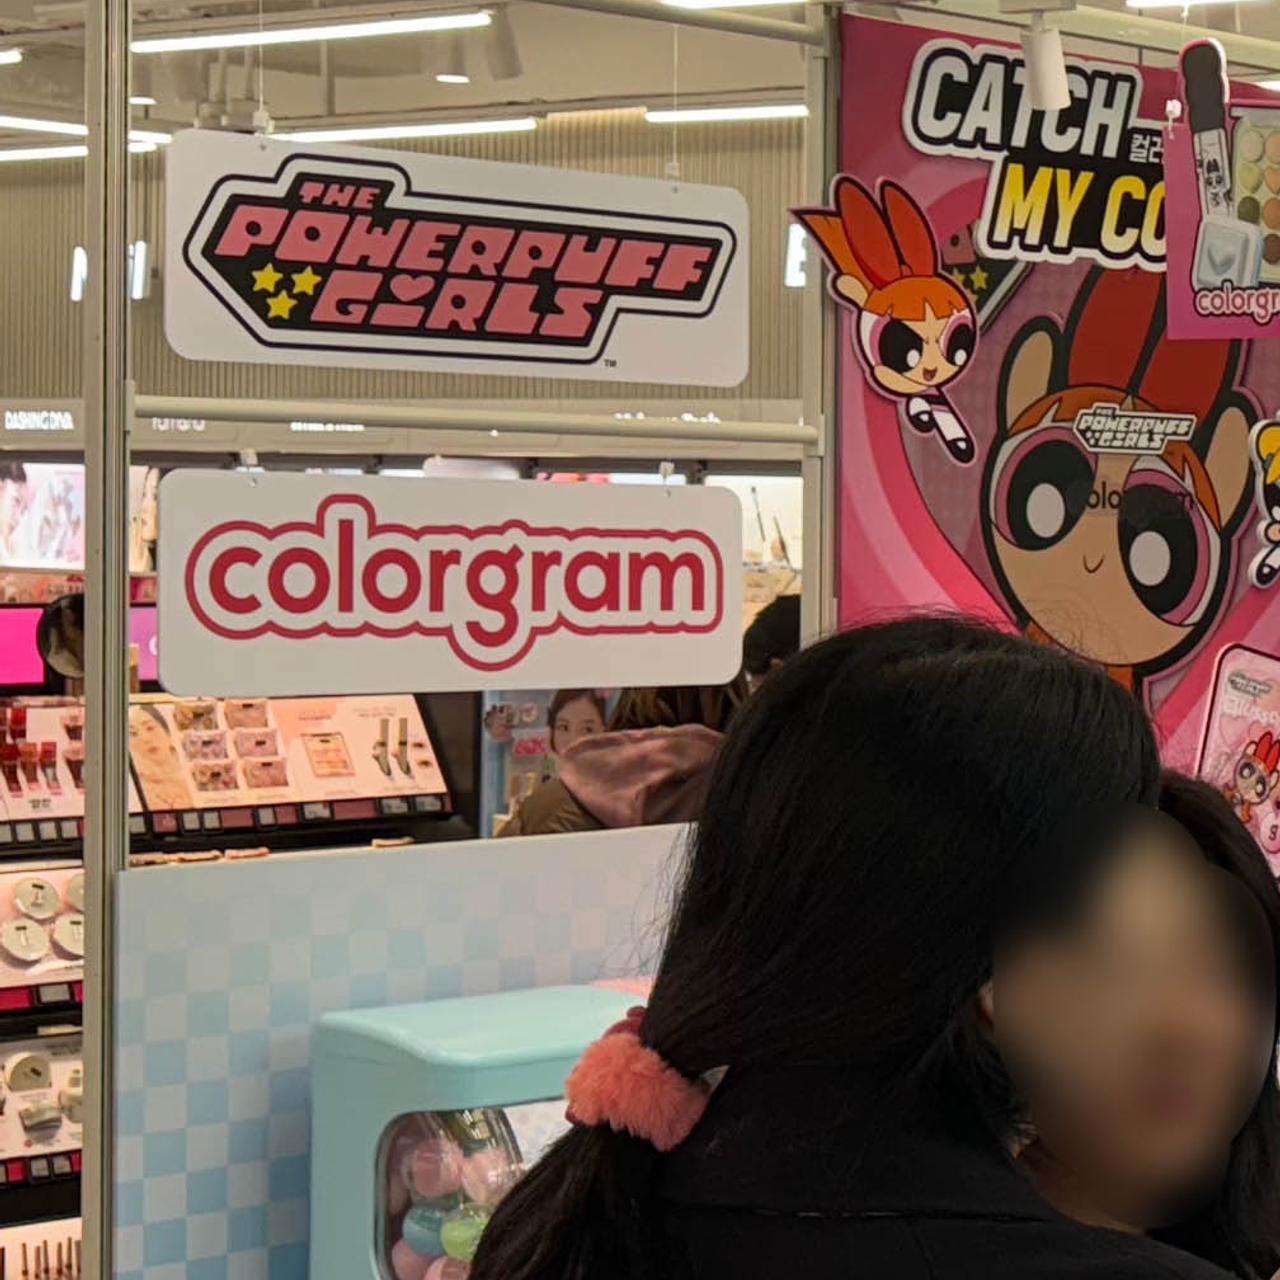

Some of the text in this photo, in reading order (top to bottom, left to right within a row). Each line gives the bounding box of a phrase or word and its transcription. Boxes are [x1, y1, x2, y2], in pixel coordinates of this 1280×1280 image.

[918, 51, 1132, 158] CATCH
[298, 181, 382, 208] THE
[992, 162, 1092, 247] MY
[214, 206, 713, 292] POWERPUFF
[310, 268, 604, 338] GIRLS
[208, 519, 705, 647] colorgram
